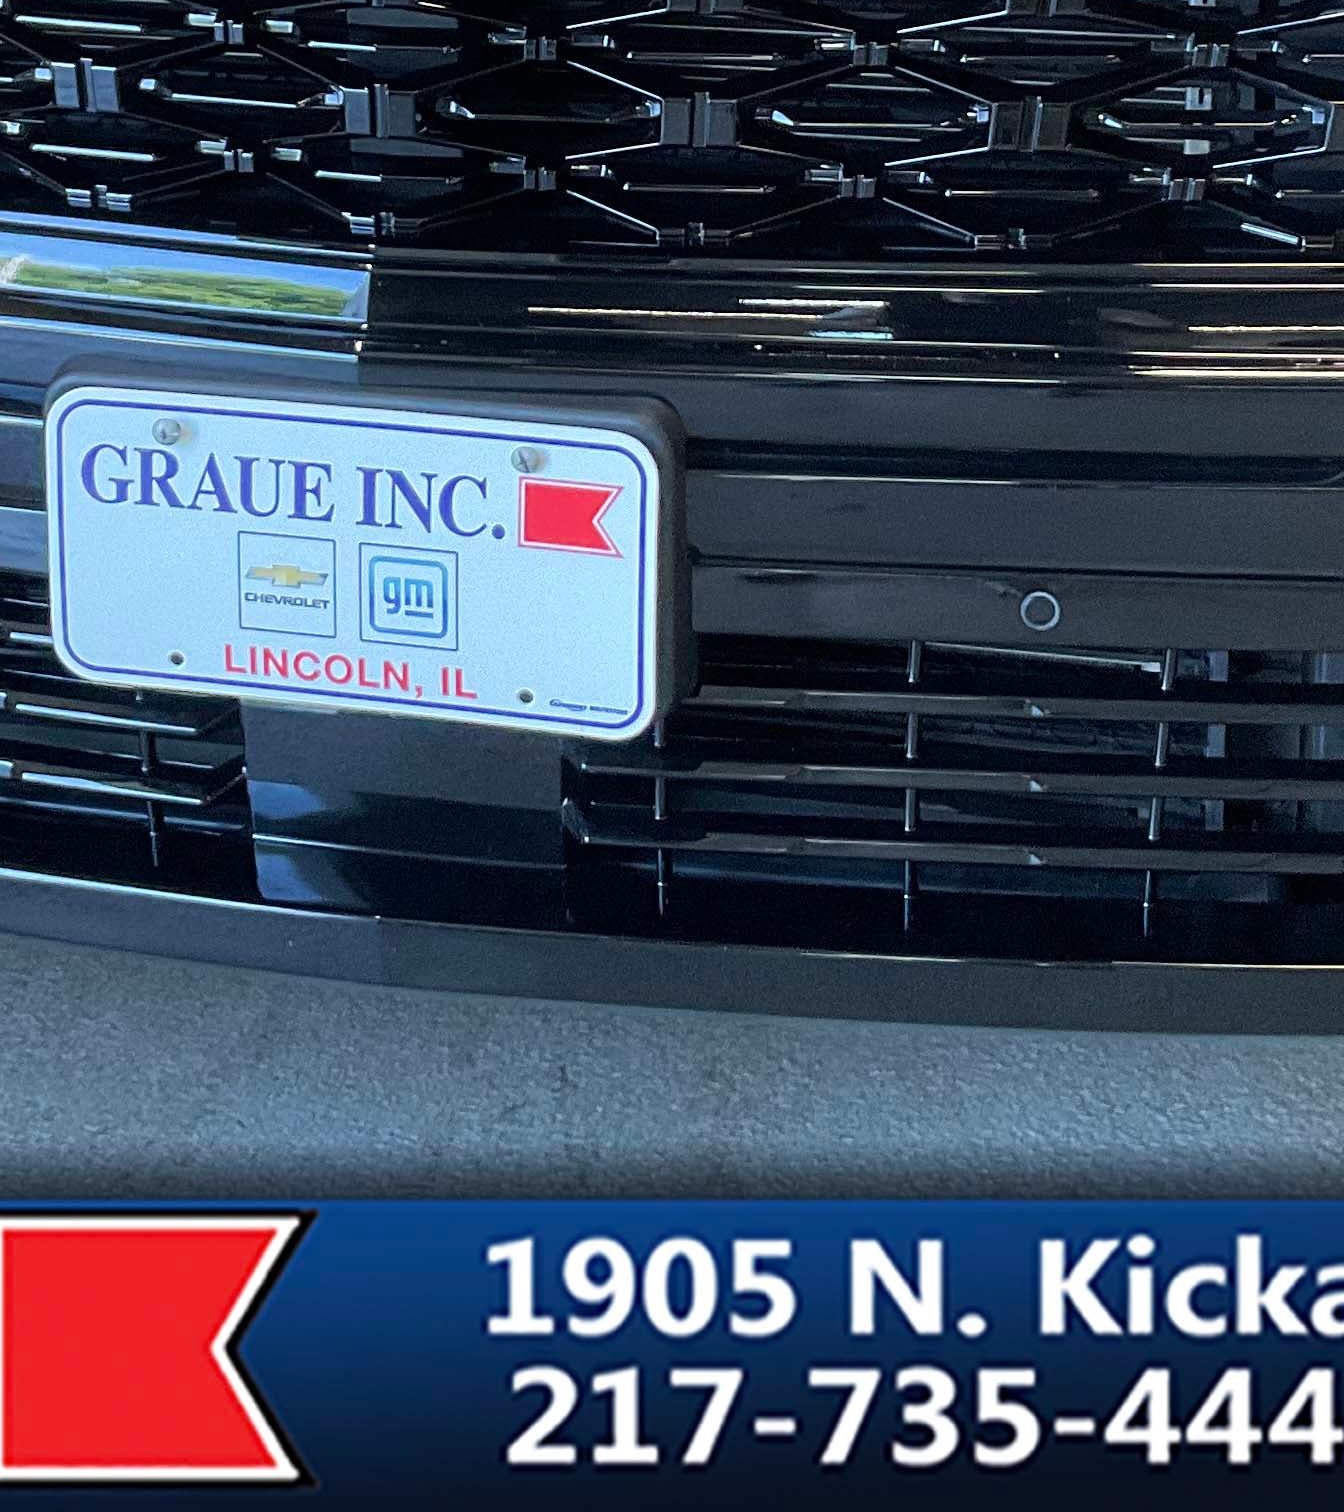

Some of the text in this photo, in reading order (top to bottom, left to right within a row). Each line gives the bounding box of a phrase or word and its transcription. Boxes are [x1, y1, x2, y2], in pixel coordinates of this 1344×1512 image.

[80, 443, 506, 541] GRAUE INC.
[244, 591, 331, 610] CHEVROLET
[382, 576, 435, 620] gm
[224, 644, 478, 700] LINCOLN, IL
